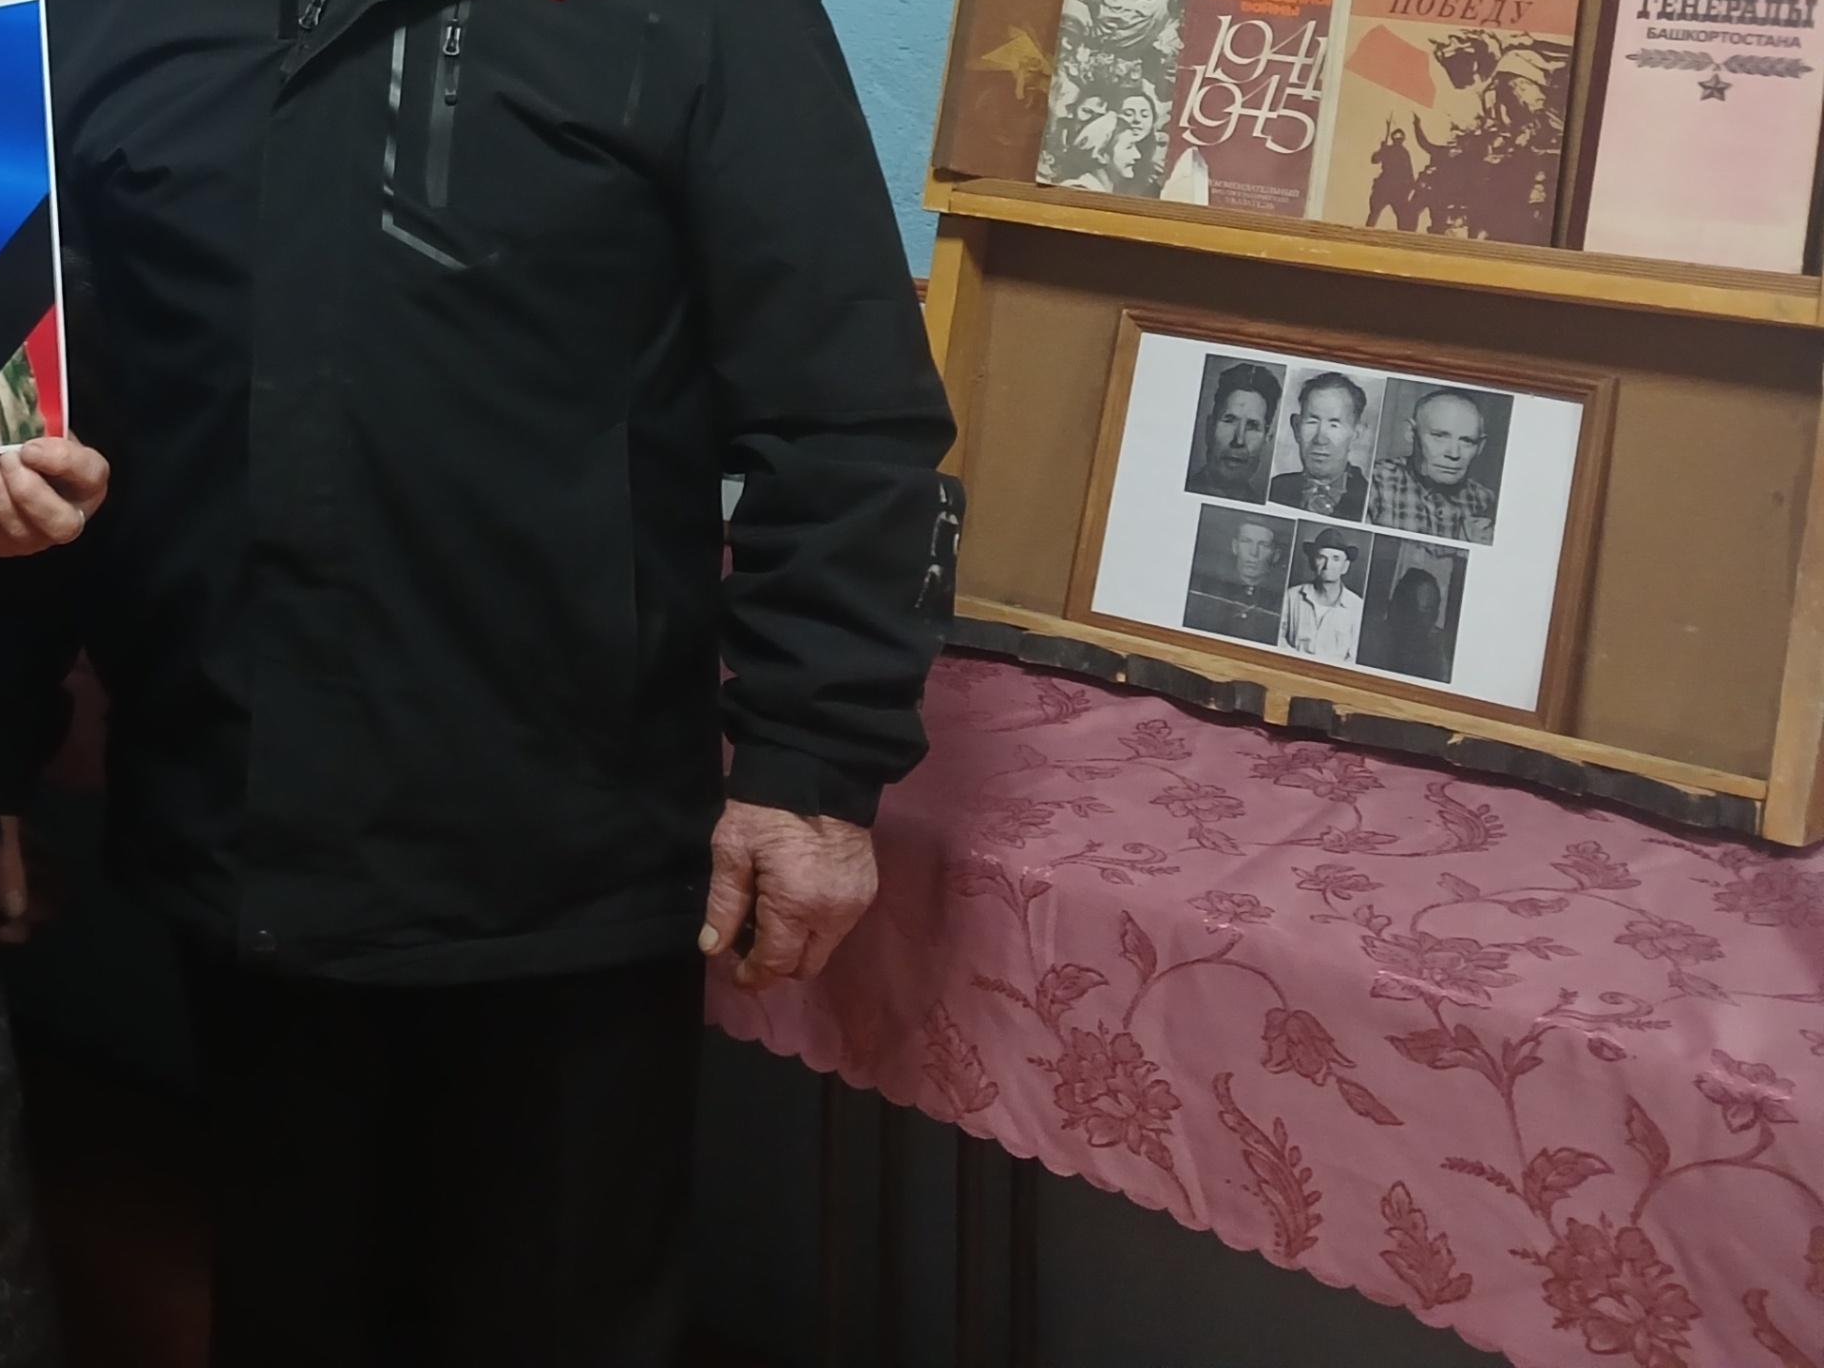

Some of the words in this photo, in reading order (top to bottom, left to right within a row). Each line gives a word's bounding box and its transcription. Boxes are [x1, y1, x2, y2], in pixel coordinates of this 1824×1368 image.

[1205, 15, 1328, 101] 1941
[1647, 27, 1802, 49] БАШКОРТОСТАНА
[1177, 66, 1316, 154] 1945
